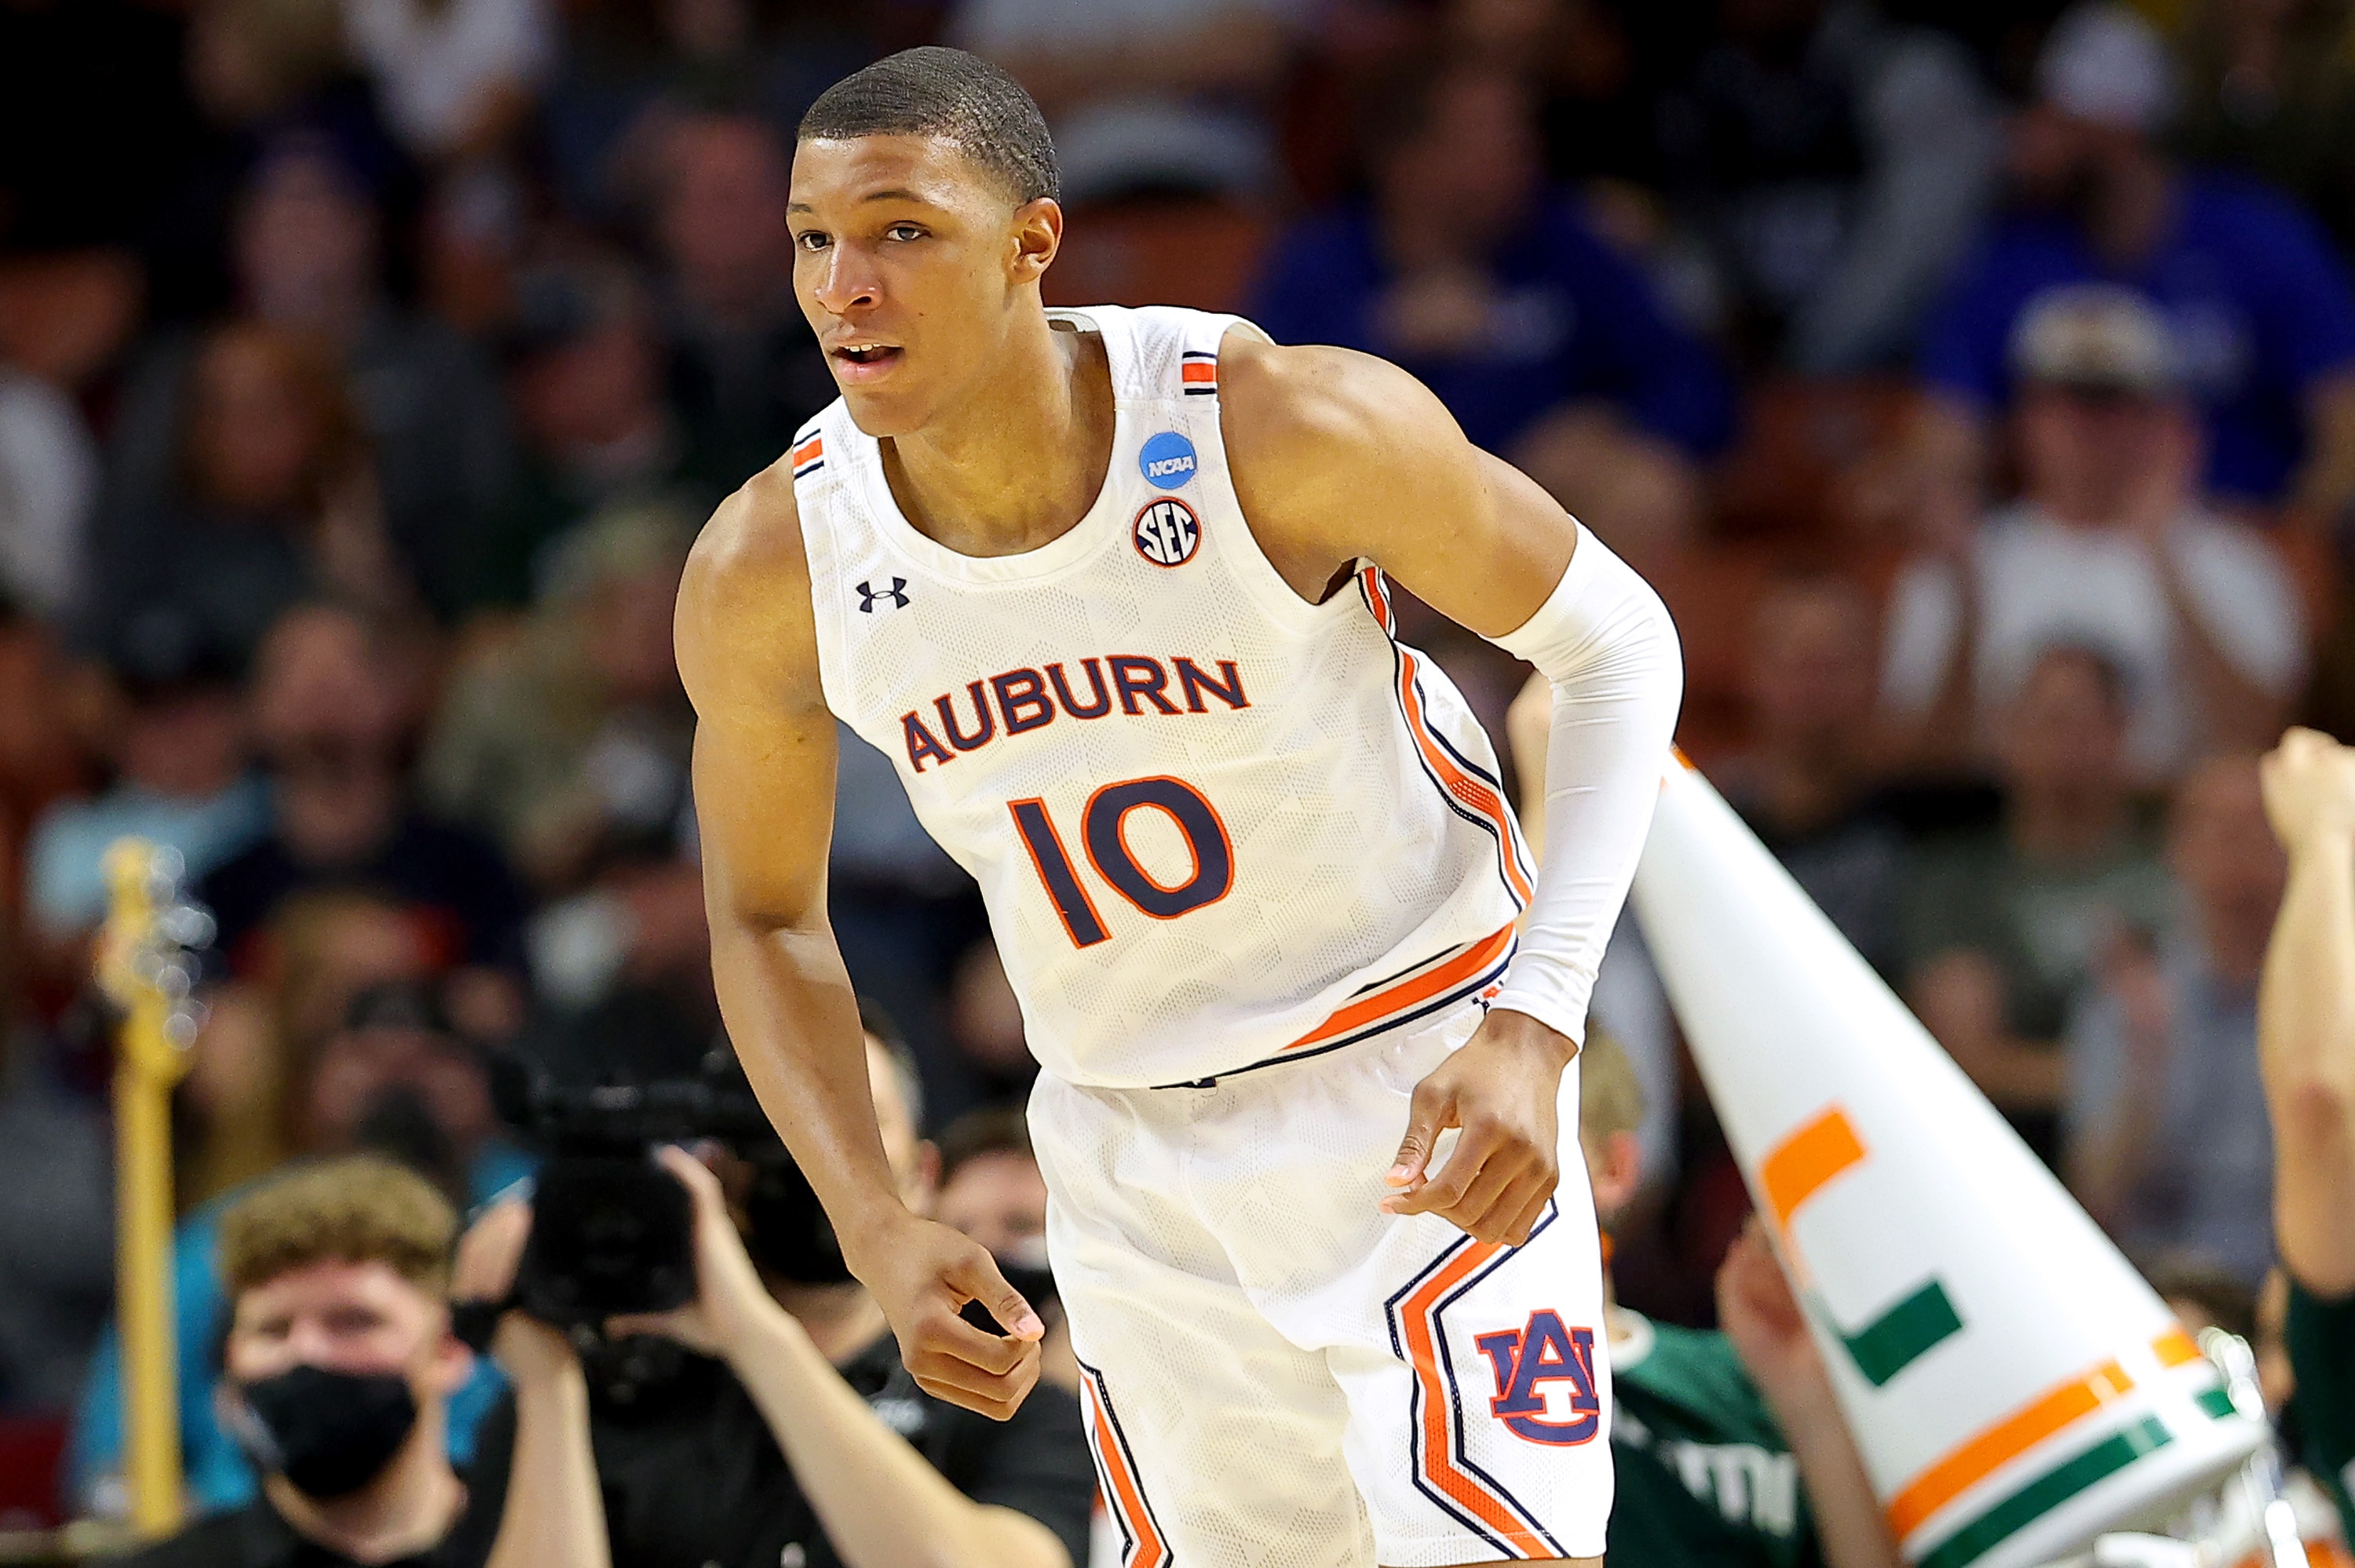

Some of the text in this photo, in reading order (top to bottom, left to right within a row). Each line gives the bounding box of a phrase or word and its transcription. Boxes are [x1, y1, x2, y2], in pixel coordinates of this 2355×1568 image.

[1148, 455, 1197, 478] NCAA
[1137, 502, 1197, 564] SEC
[900, 655, 1252, 774] AUBURN
[1006, 774, 1235, 950] 10
